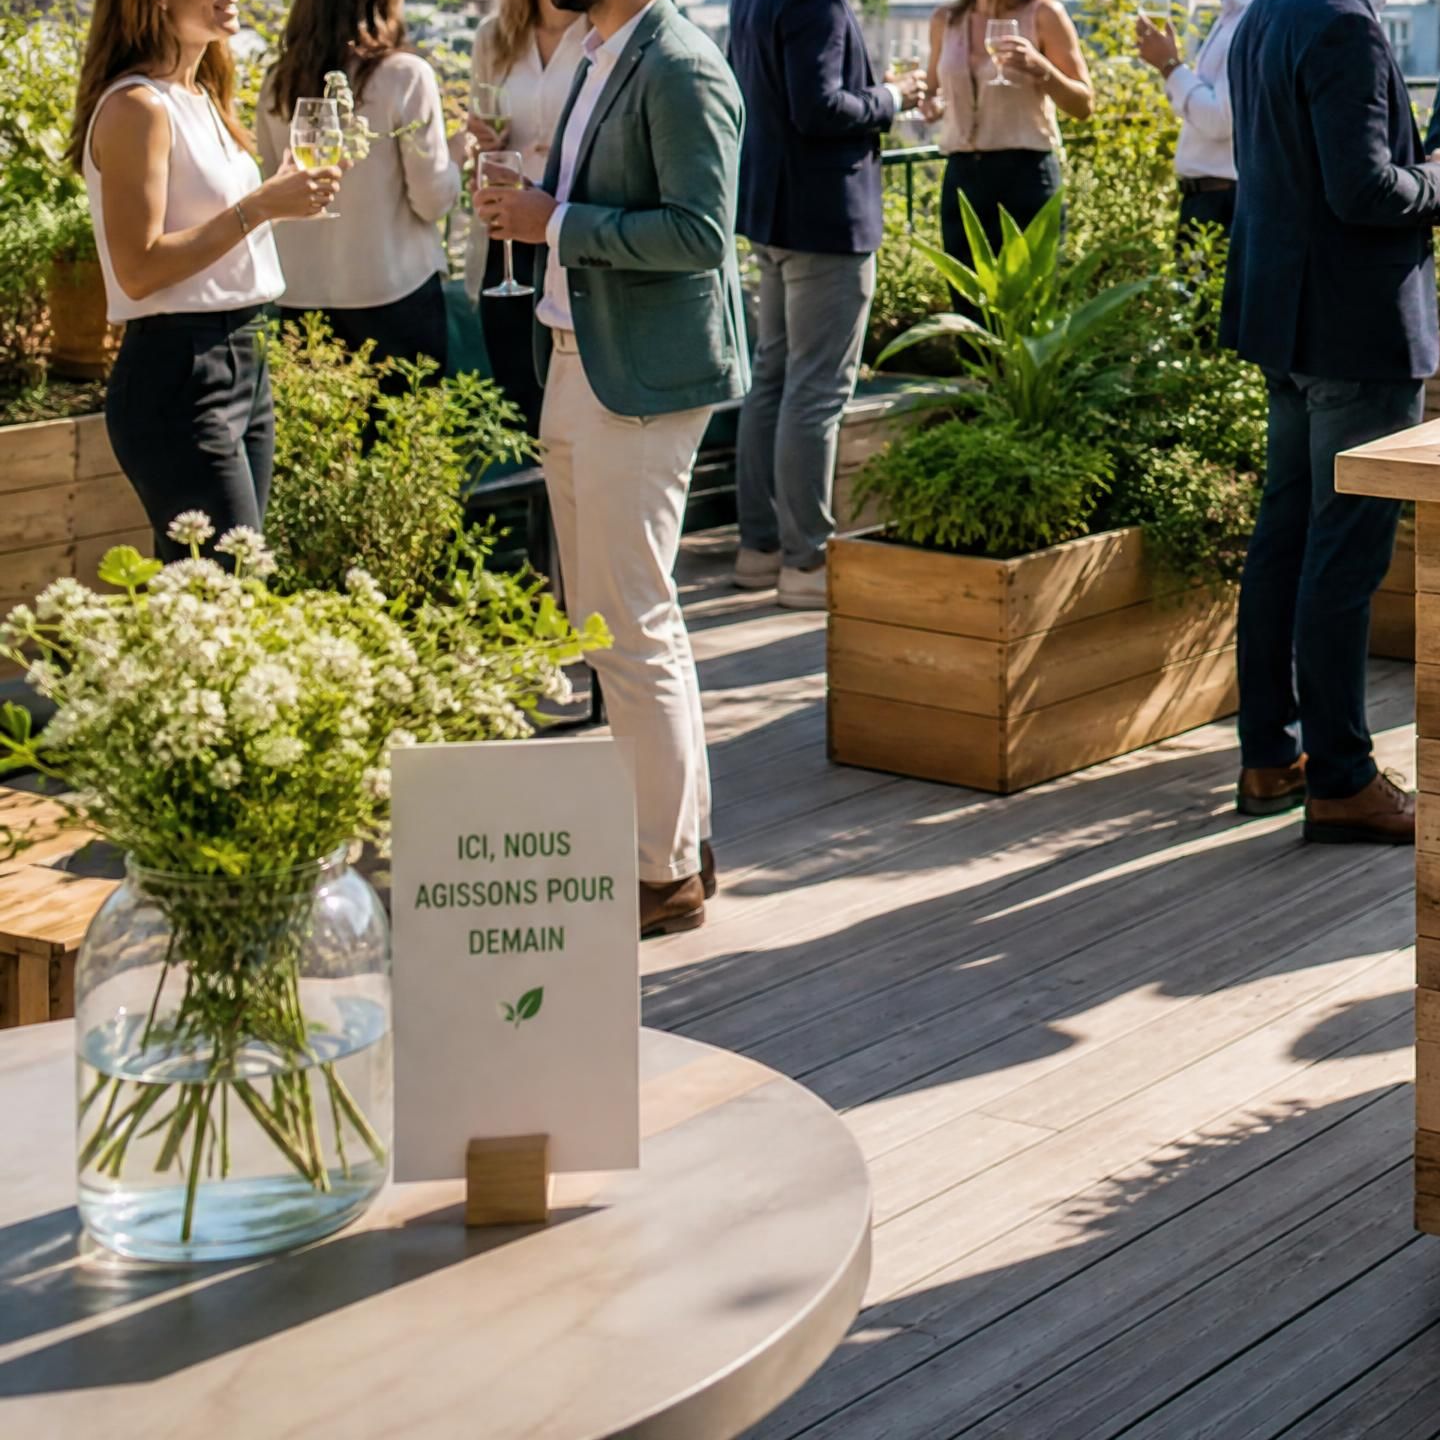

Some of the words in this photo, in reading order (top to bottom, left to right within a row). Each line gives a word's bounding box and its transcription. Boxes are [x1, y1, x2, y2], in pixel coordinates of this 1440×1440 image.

[457, 834, 496, 863] ICI,
[504, 831, 571, 858] NOUS
[414, 879, 538, 909] AGISSONS
[546, 875, 614, 903] POUR
[468, 926, 565, 955] DEMAIN
